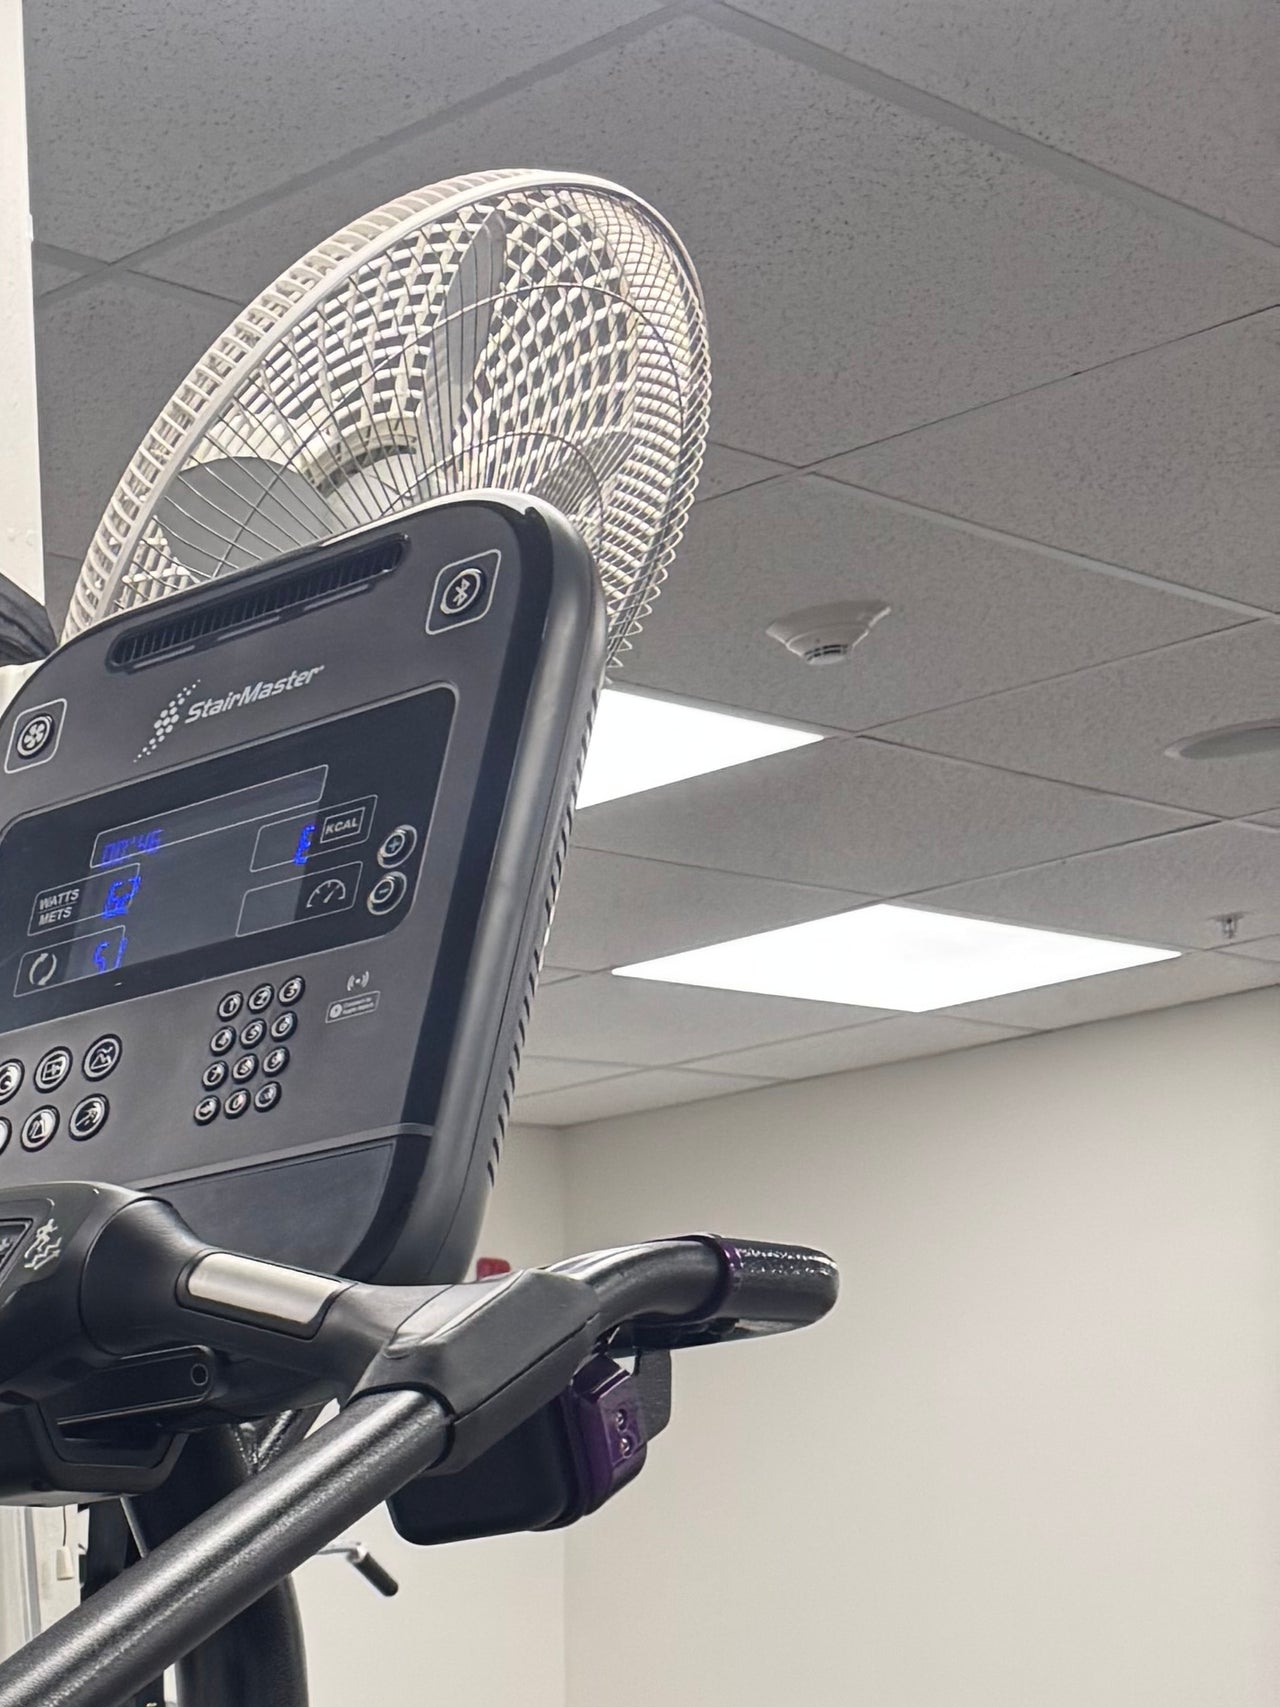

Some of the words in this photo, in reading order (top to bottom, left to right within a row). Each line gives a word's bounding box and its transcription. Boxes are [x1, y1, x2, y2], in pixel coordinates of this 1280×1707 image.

[184, 665, 320, 724] StairMaster
[324, 817, 359, 835] KCAL
[39, 888, 80, 910] WATTS
[38, 906, 73, 926] METS
